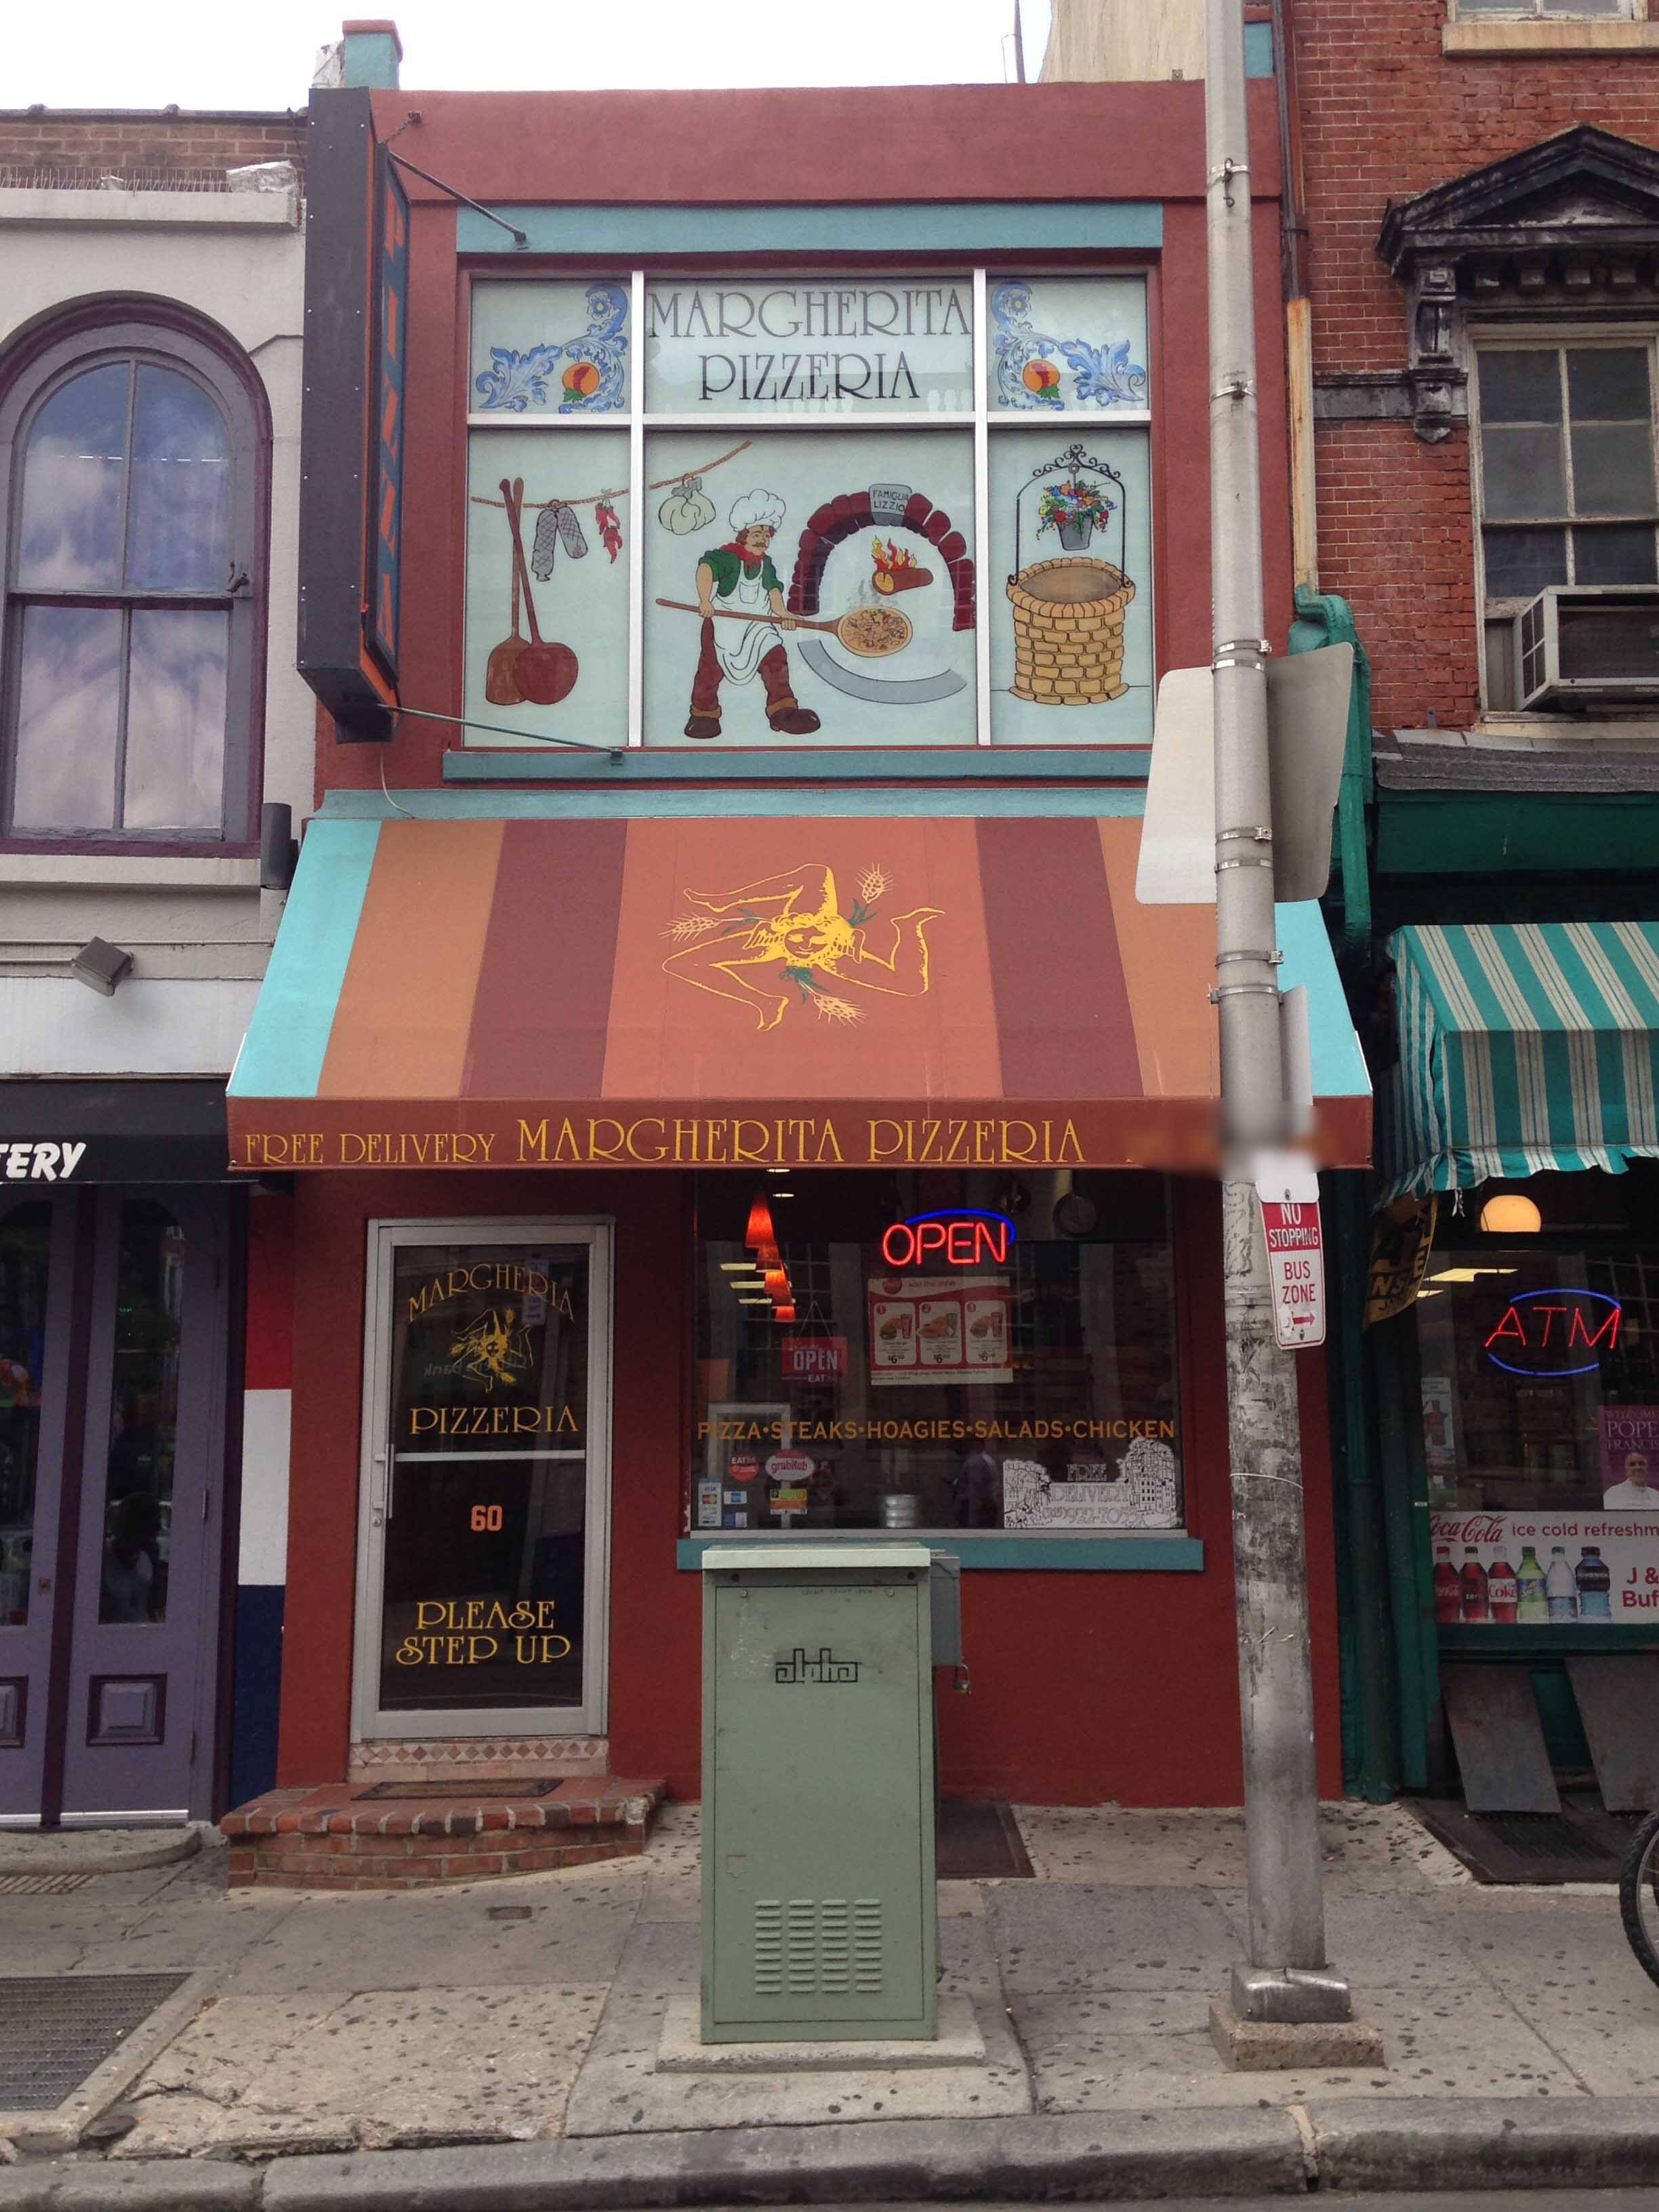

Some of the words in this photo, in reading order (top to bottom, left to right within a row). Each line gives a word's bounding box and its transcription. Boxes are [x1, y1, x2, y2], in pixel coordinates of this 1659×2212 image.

[648, 289, 973, 337] MARGHERITA
[698, 352, 920, 402] PIZZERIA
[873, 500, 905, 512] LIZZIO
[245, 1133, 324, 1164] FREE
[340, 1133, 496, 1164] DELIVERY
[516, 1118, 844, 1162] MARGHERITA
[867, 1119, 1086, 1164] PIZZERIA
[0, 1142, 87, 1181] ERY
[1280, 1203, 1301, 1225] NO
[882, 1221, 1008, 1266] OPEN
[1269, 1227, 1319, 1248] STOPPING
[1284, 1261, 1311, 1280] BUS
[408, 1263, 575, 1324] MARGHERIA
[1282, 1284, 1316, 1304] ZONE
[1485, 1307, 1620, 1349] ATM
[793, 1349, 838, 1370] OPEN
[409, 1406, 578, 1435] PIZZERIA
[697, 1420, 762, 1439] PIZZA
[771, 1420, 857, 1439] STEAKS
[867, 1420, 966, 1439] HOAGIES
[975, 1420, 1064, 1439] SALADS
[1072, 1420, 1174, 1438] CHICKEN
[1607, 1420, 1659, 1437] POPE
[471, 1505, 502, 1532] 60
[1429, 1515, 1508, 1544] Coca-Cola
[1512, 1523, 1536, 1536] ice
[1542, 1523, 1578, 1536] cold
[1626, 1567, 1637, 1584] J
[1645, 1567, 1659, 1584] &
[415, 1600, 555, 1630] PLEASE
[395, 1634, 497, 1665] STEP
[516, 1635, 571, 1664] UP
[775, 1647, 859, 1683] alpha
